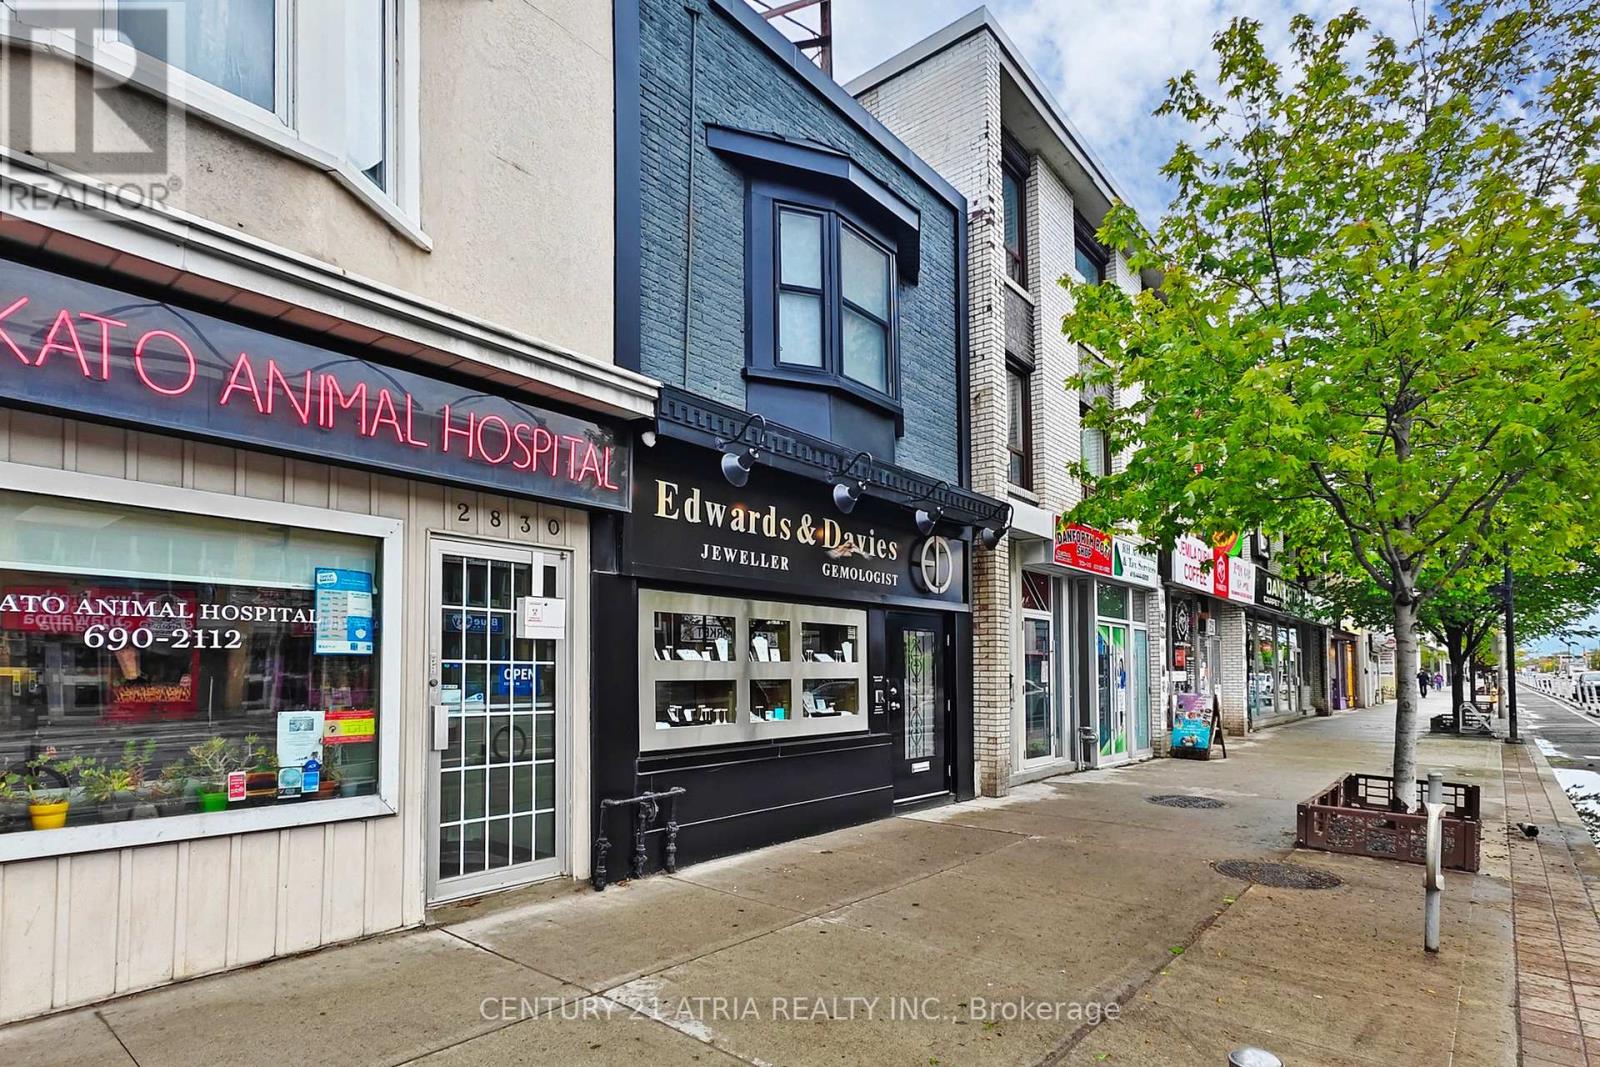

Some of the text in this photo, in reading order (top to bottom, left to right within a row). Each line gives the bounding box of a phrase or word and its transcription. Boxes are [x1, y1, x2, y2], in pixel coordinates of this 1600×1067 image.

[0, 296, 620, 492] KATO ANIMAL HOSPITAL
[457, 503, 560, 536] 2830
[654, 479, 792, 542] Edwards
[821, 516, 898, 561] Davies
[700, 543, 900, 588] JEWELLER GEMOLOGIST
[1077, 544, 1093, 558] SHOP
[73, 598, 194, 620] ANIMAL
[200, 604, 321, 625] HOSPITAL
[83, 624, 242, 652] 690-2112
[504, 668, 534, 681] OPEN
